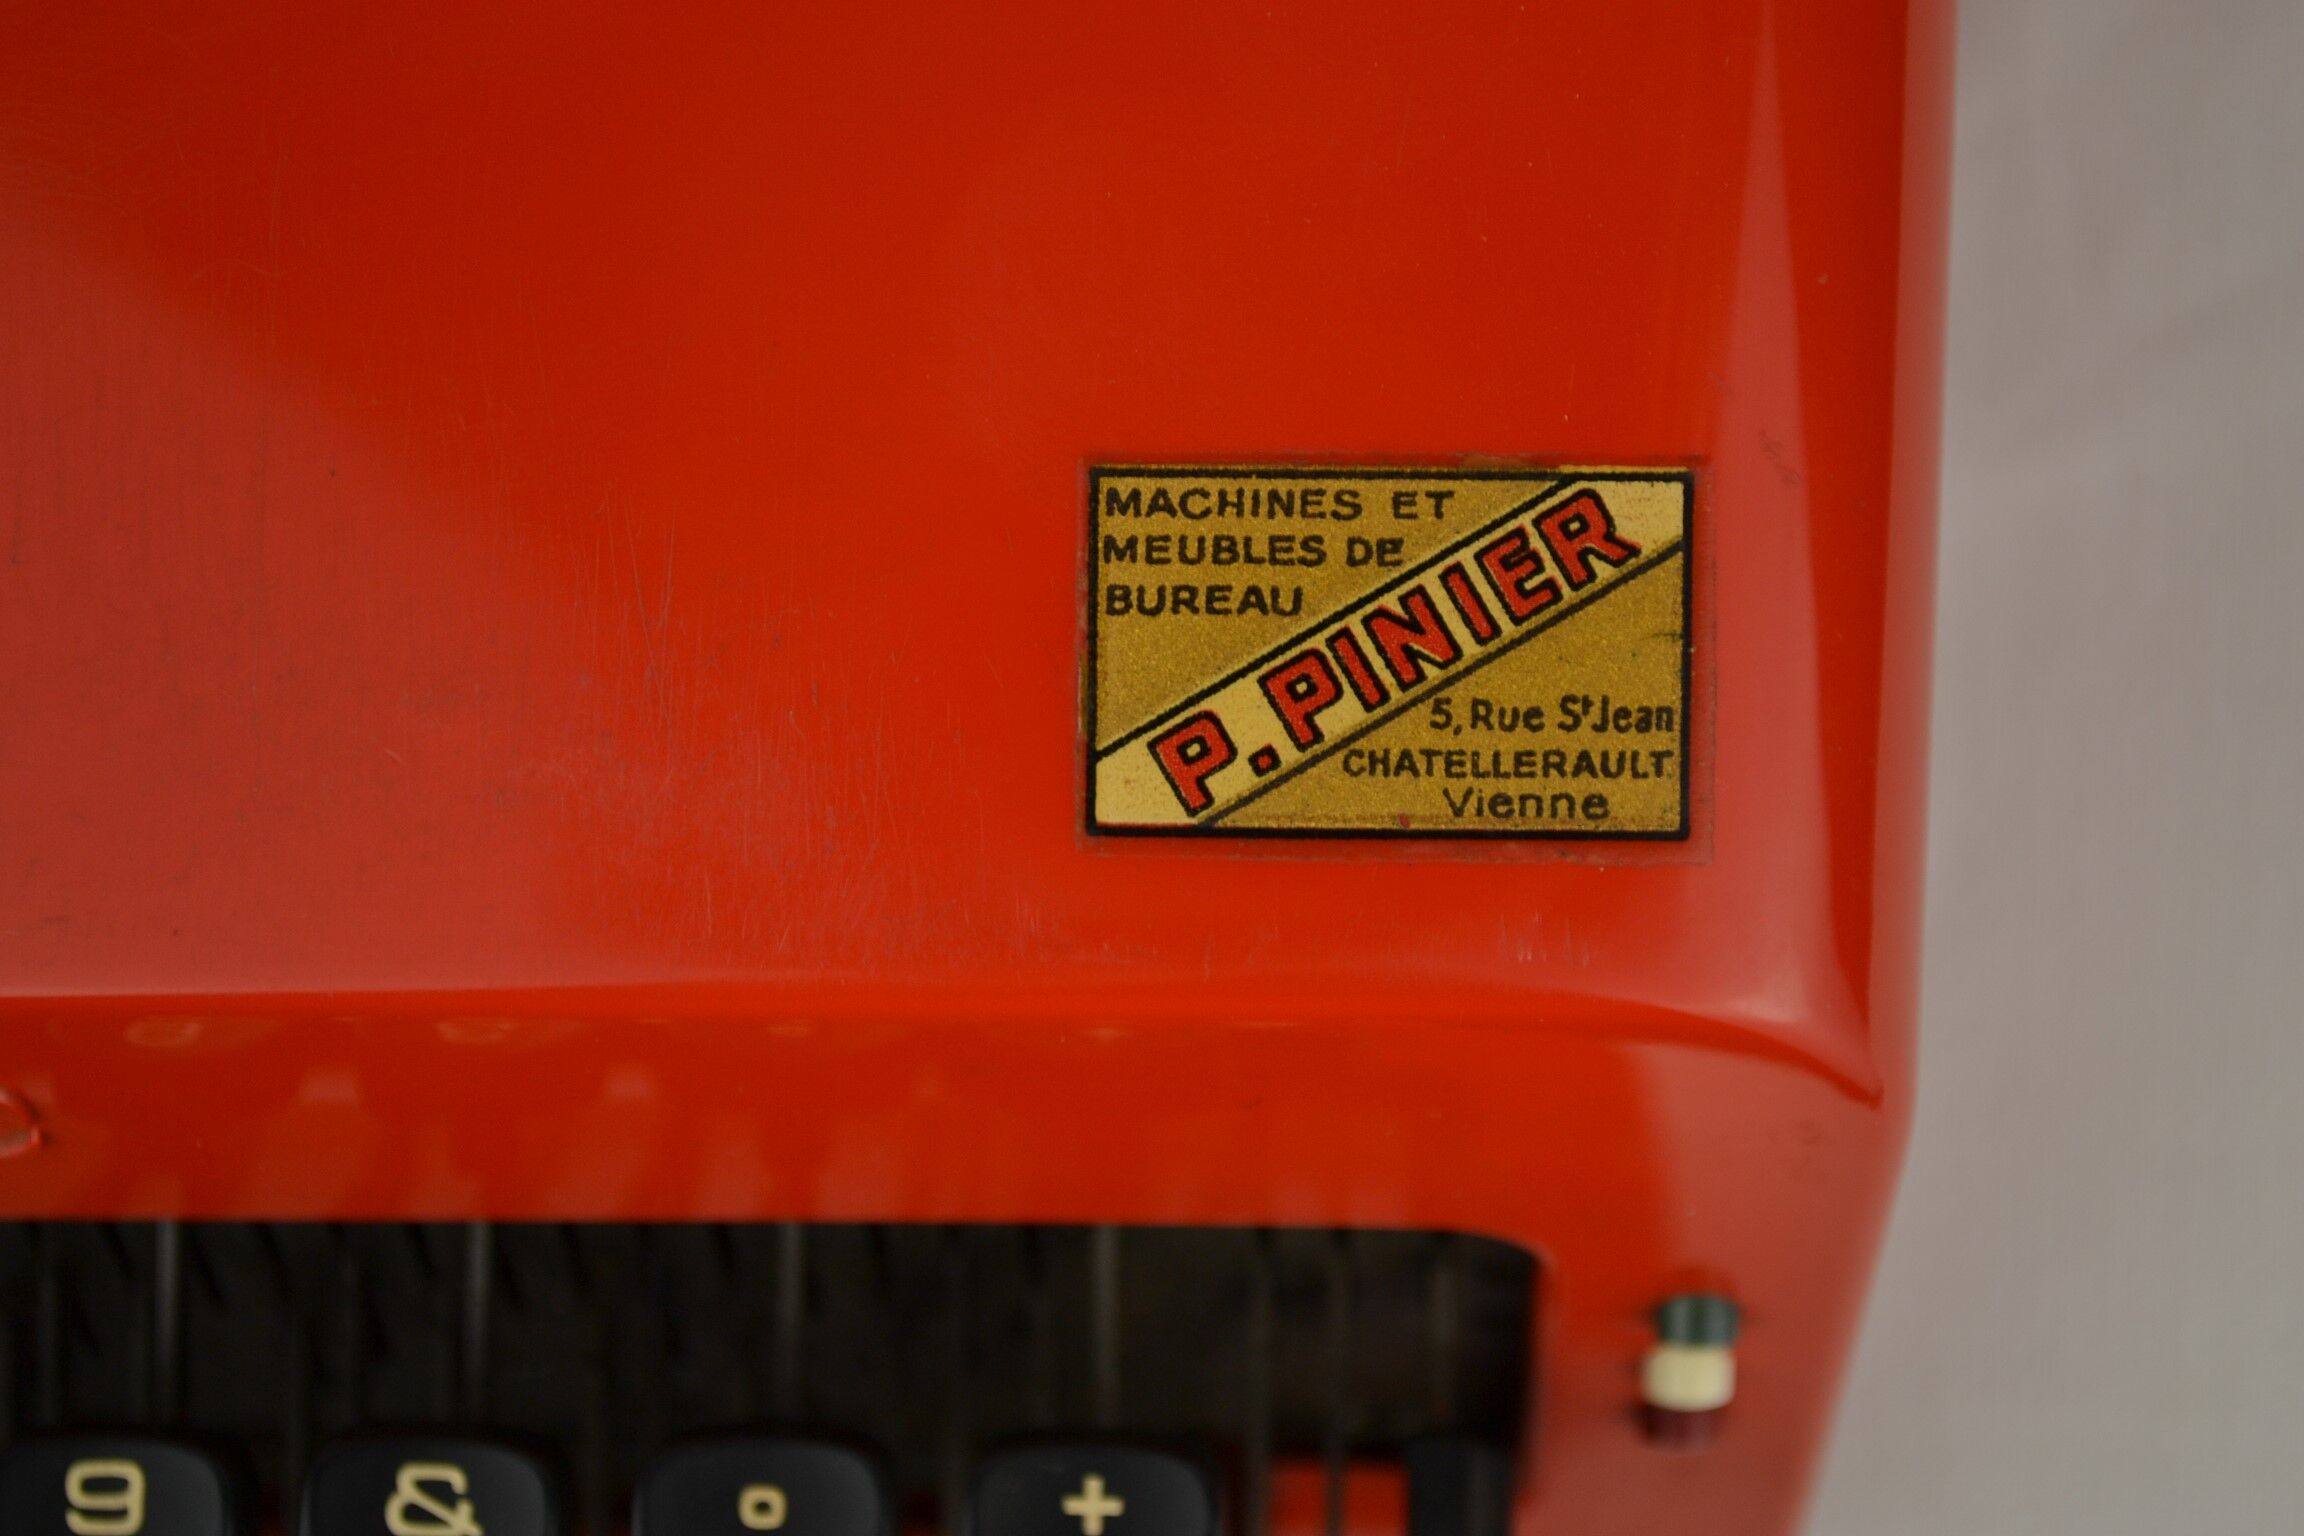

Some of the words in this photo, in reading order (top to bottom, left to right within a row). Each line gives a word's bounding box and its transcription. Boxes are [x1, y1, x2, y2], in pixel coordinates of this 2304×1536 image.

[1105, 487, 1363, 520] MACHINES
[1391, 490, 1455, 520] ET
[1103, 534, 1328, 567] MEUBLES
[1345, 536, 1405, 567] DE
[1105, 584, 1304, 616] BUREAU
[1342, 749, 1675, 779] CHATELLERAULT
[1442, 786, 1611, 820] Vienne
